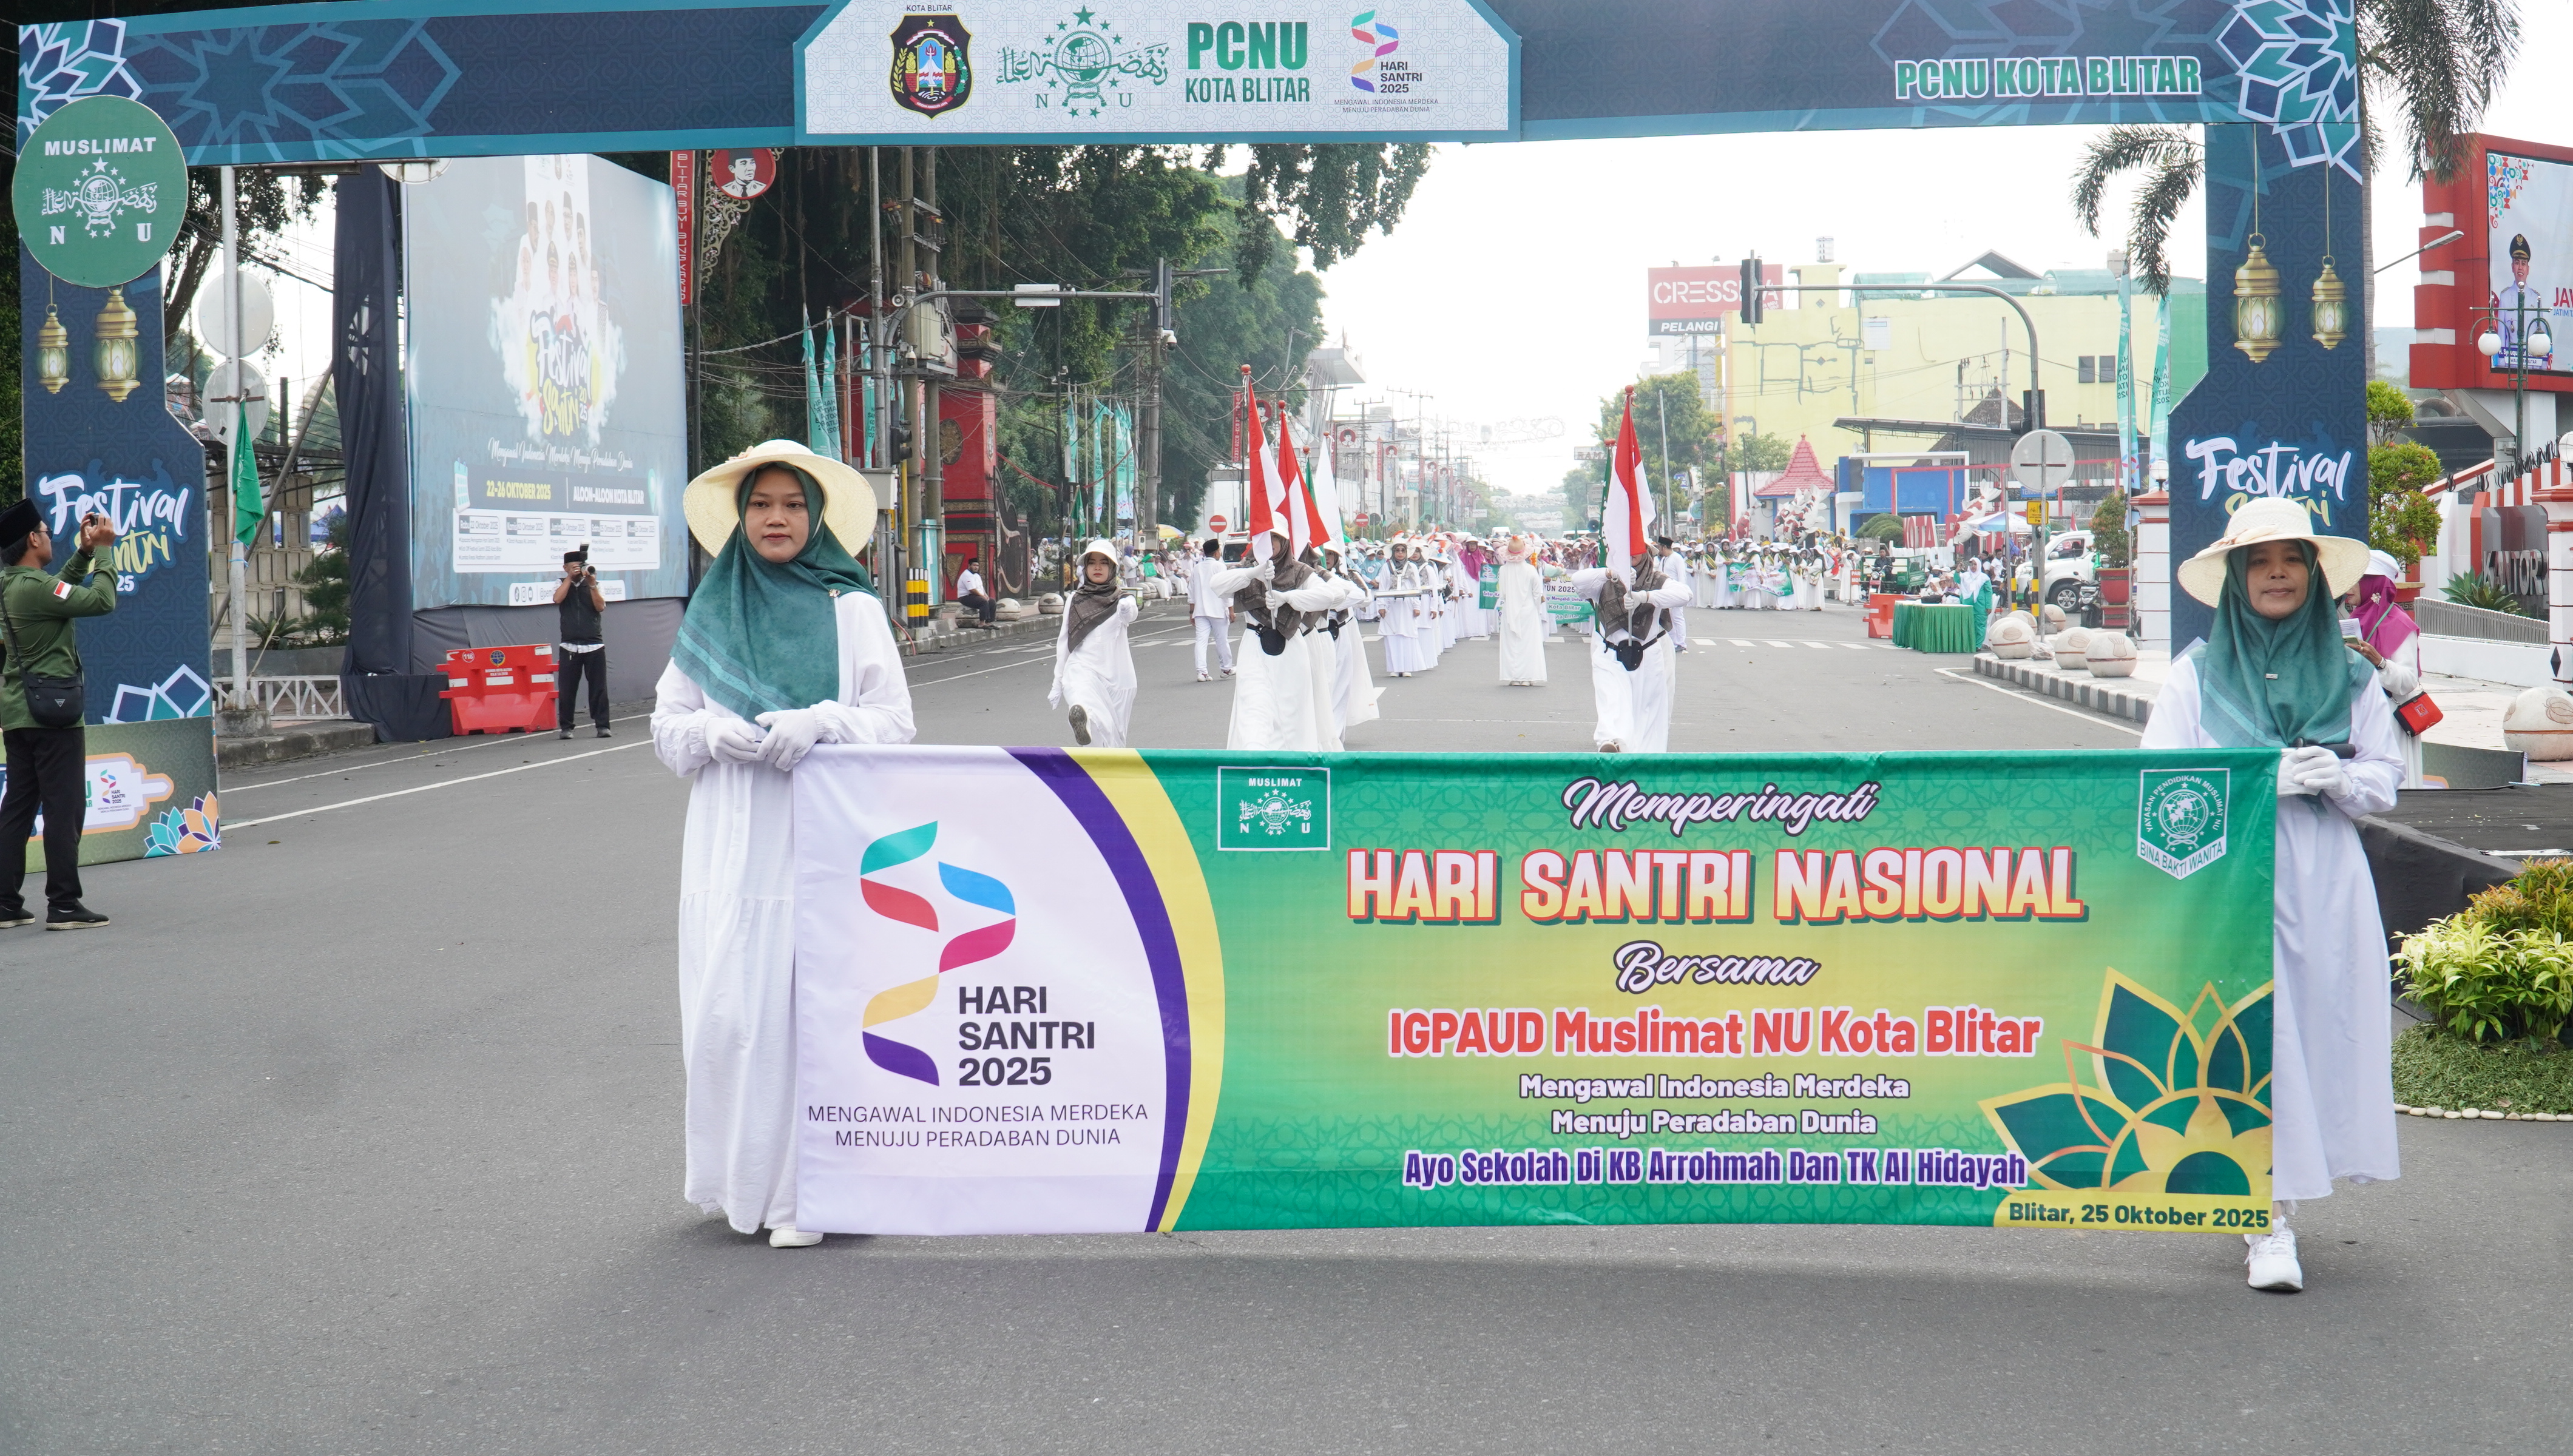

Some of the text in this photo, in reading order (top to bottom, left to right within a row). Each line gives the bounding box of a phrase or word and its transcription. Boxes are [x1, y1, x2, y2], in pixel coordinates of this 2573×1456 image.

[1188, 21, 1308, 70] PCNU
[1381, 62, 1408, 70] HARI
[1381, 73, 1422, 82] SANTRI
[1895, 56, 2202, 99] PCNU KOTA BLITAR
[1035, 93, 1132, 109] N U
[1186, 77, 1310, 102] KOTA BLITAR
[1381, 84, 1409, 93] 2025
[45, 137, 157, 156] MUSLIMAT
[677, 153, 688, 197] BLITAR
[677, 200, 688, 229] BUMI
[50, 223, 152, 244] N U
[678, 232, 687, 261] BUNG
[1661, 321, 1719, 332] PELANGI
[2553, 309, 2569, 317] JATIM
[531, 314, 592, 401] Festival
[543, 378, 580, 436] Santri
[579, 385, 587, 403] 20
[580, 403, 588, 421] 25
[2185, 437, 2352, 501] Festival
[486, 480, 552, 500] 22-26 OKTOBER 2025
[573, 486, 645, 505] ALOON-ALOON KOTA BLITAR
[39, 474, 189, 536] Festival
[2483, 549, 2544, 596] KANTOR
[1248, 778, 1302, 787] MUSLIMAT
[1561, 777, 1881, 837] Memperingati
[2143, 775, 2224, 832] YAYASAN PENDIDIKAN MUSLIMAT NU
[1240, 823, 1311, 834] N U
[2140, 841, 2223, 877] BINA BAKTI WANITA
[1347, 846, 2086, 923] HARI SANTRI NASIONAL
[1613, 940, 1822, 995] Bersama
[959, 986, 1047, 1014] HARI
[958, 1021, 1095, 1050] SANTRI
[1389, 1004, 2043, 1057] IGPAUD Muslimat NU Kota Blitar
[958, 1057, 1052, 1086] 2025
[1520, 1073, 1910, 1103] Mengawal Indonesia Merdeka
[808, 1104, 1148, 1122] MENGAWAL INDONESIA MERDEKA
[1551, 1108, 1878, 1139] Menuju Peradaban Dunia
[836, 1128, 1121, 1147] MENUJU PERADABAN DUNIA
[1402, 1147, 2028, 1190] Ayo Sekolah Di KB Arrohmah Dan TK Al Hidayah
[2009, 1202, 2269, 1228] Blitar, 25 Oktober 2025
